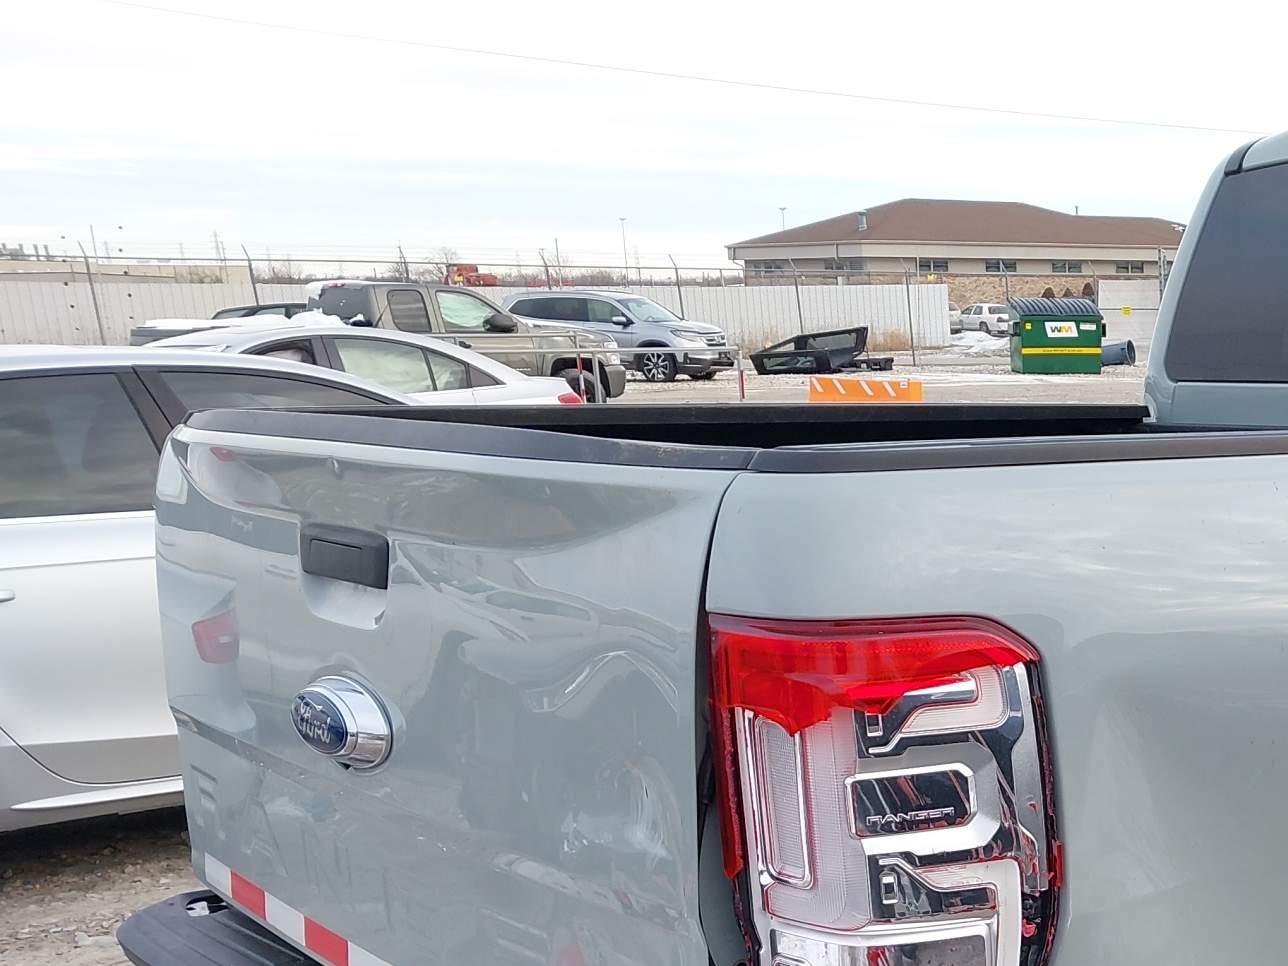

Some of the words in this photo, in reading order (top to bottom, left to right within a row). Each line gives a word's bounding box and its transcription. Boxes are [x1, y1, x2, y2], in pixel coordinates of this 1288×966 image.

[1050, 325, 1072, 333] WM
[297, 697, 331, 744] Ford
[866, 806, 955, 826] RANGER
